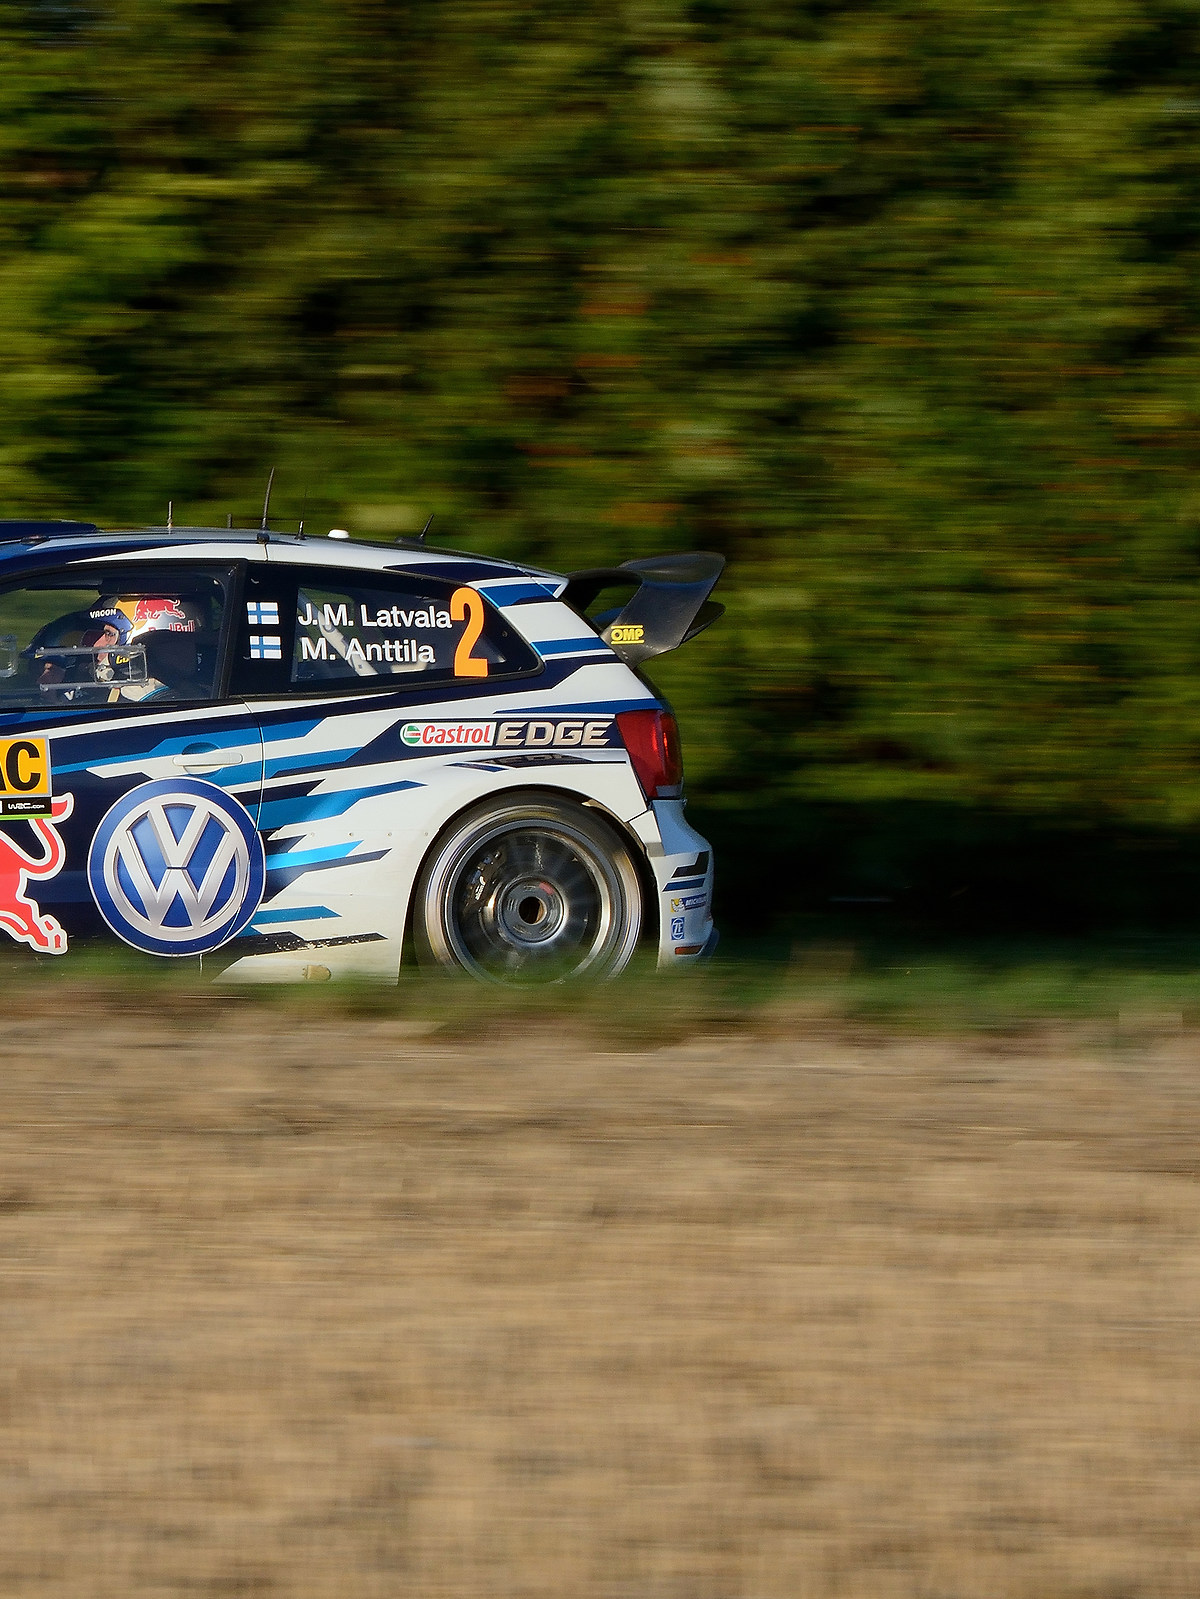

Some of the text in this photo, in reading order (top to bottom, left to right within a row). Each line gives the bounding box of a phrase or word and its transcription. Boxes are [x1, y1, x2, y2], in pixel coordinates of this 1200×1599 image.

[361, 604, 452, 628] Latvala
[450, 587, 489, 677] 2
[610, 626, 644, 642] OMP
[301, 637, 436, 663] M. Anttila
[422, 722, 613, 746] Castrol EDGE
